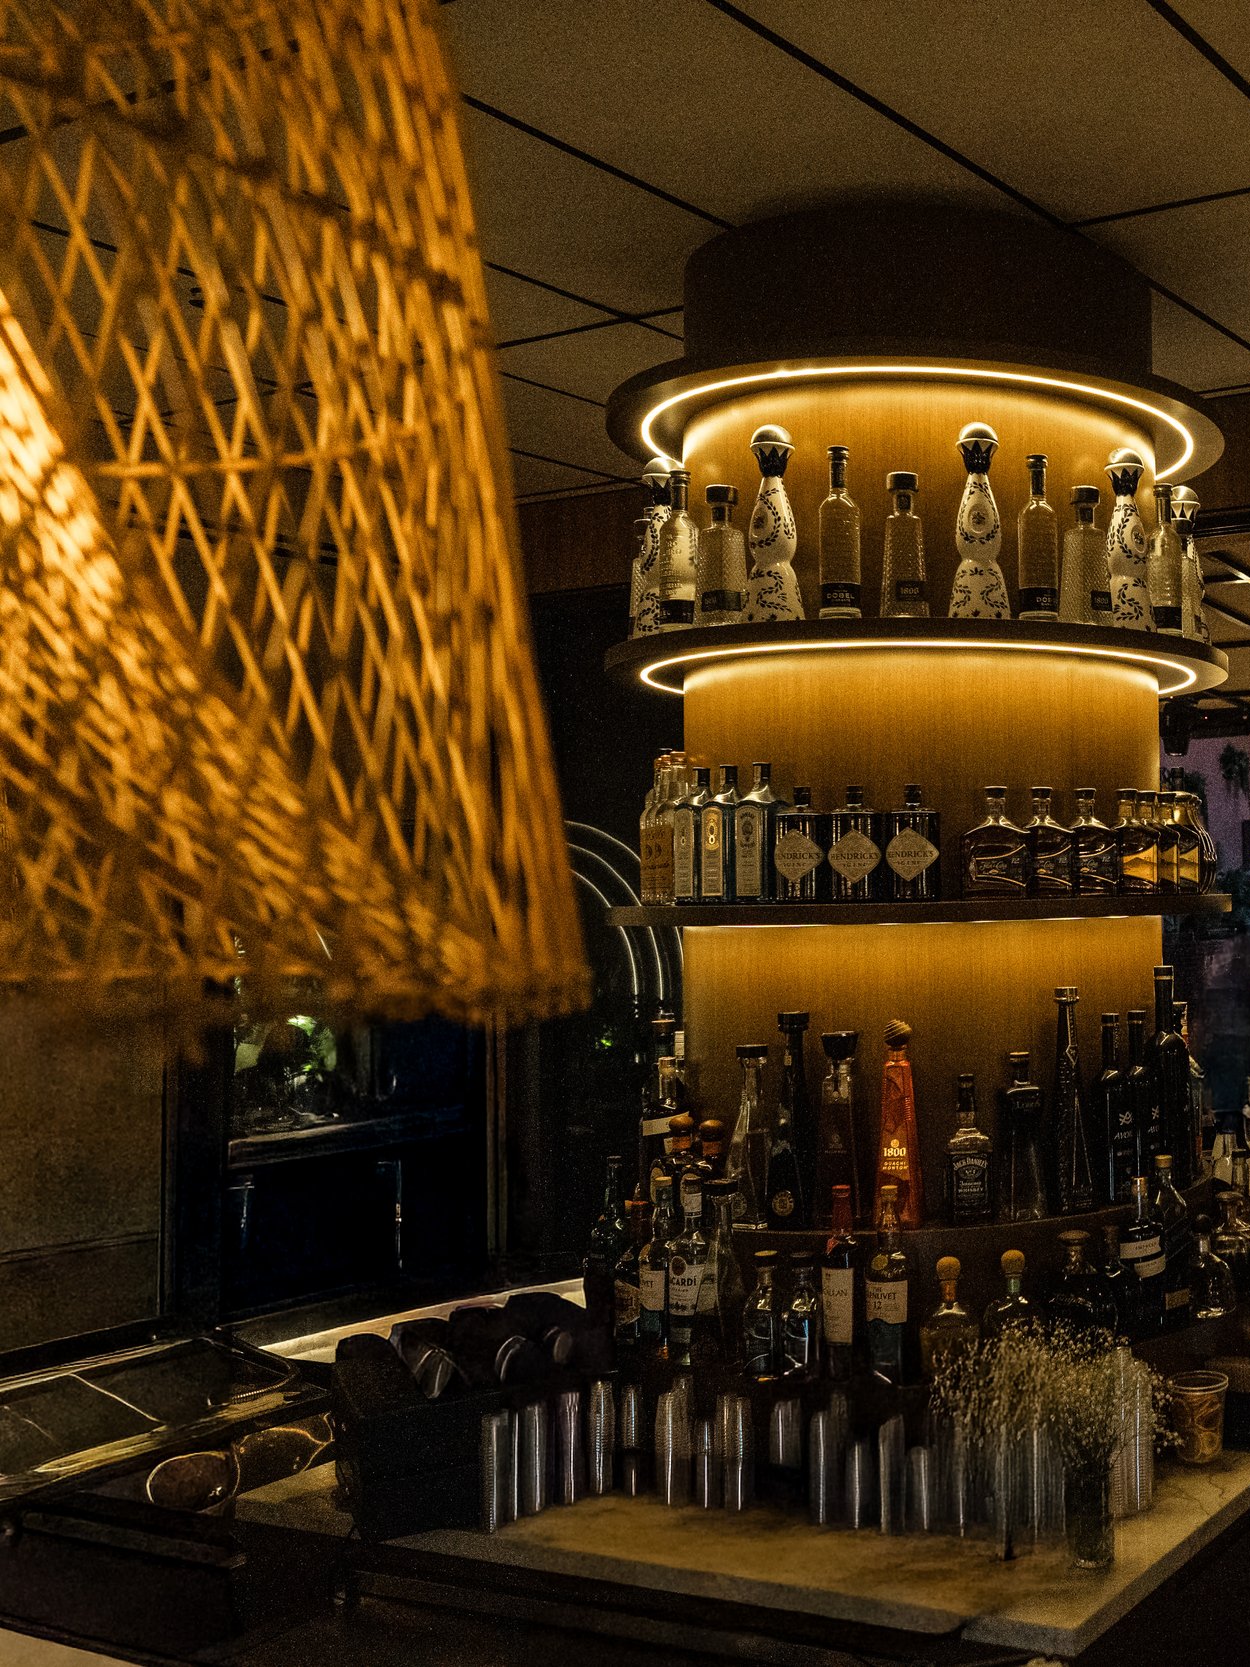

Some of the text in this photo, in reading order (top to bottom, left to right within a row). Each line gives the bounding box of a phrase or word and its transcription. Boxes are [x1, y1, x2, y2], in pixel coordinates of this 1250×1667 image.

[900, 587, 920, 595] 1800
[826, 592, 855, 600] DOBEL
[883, 1147, 907, 1157] 1800
[670, 1276, 697, 1287] CARDÍ
[873, 1301, 882, 1310] 12
